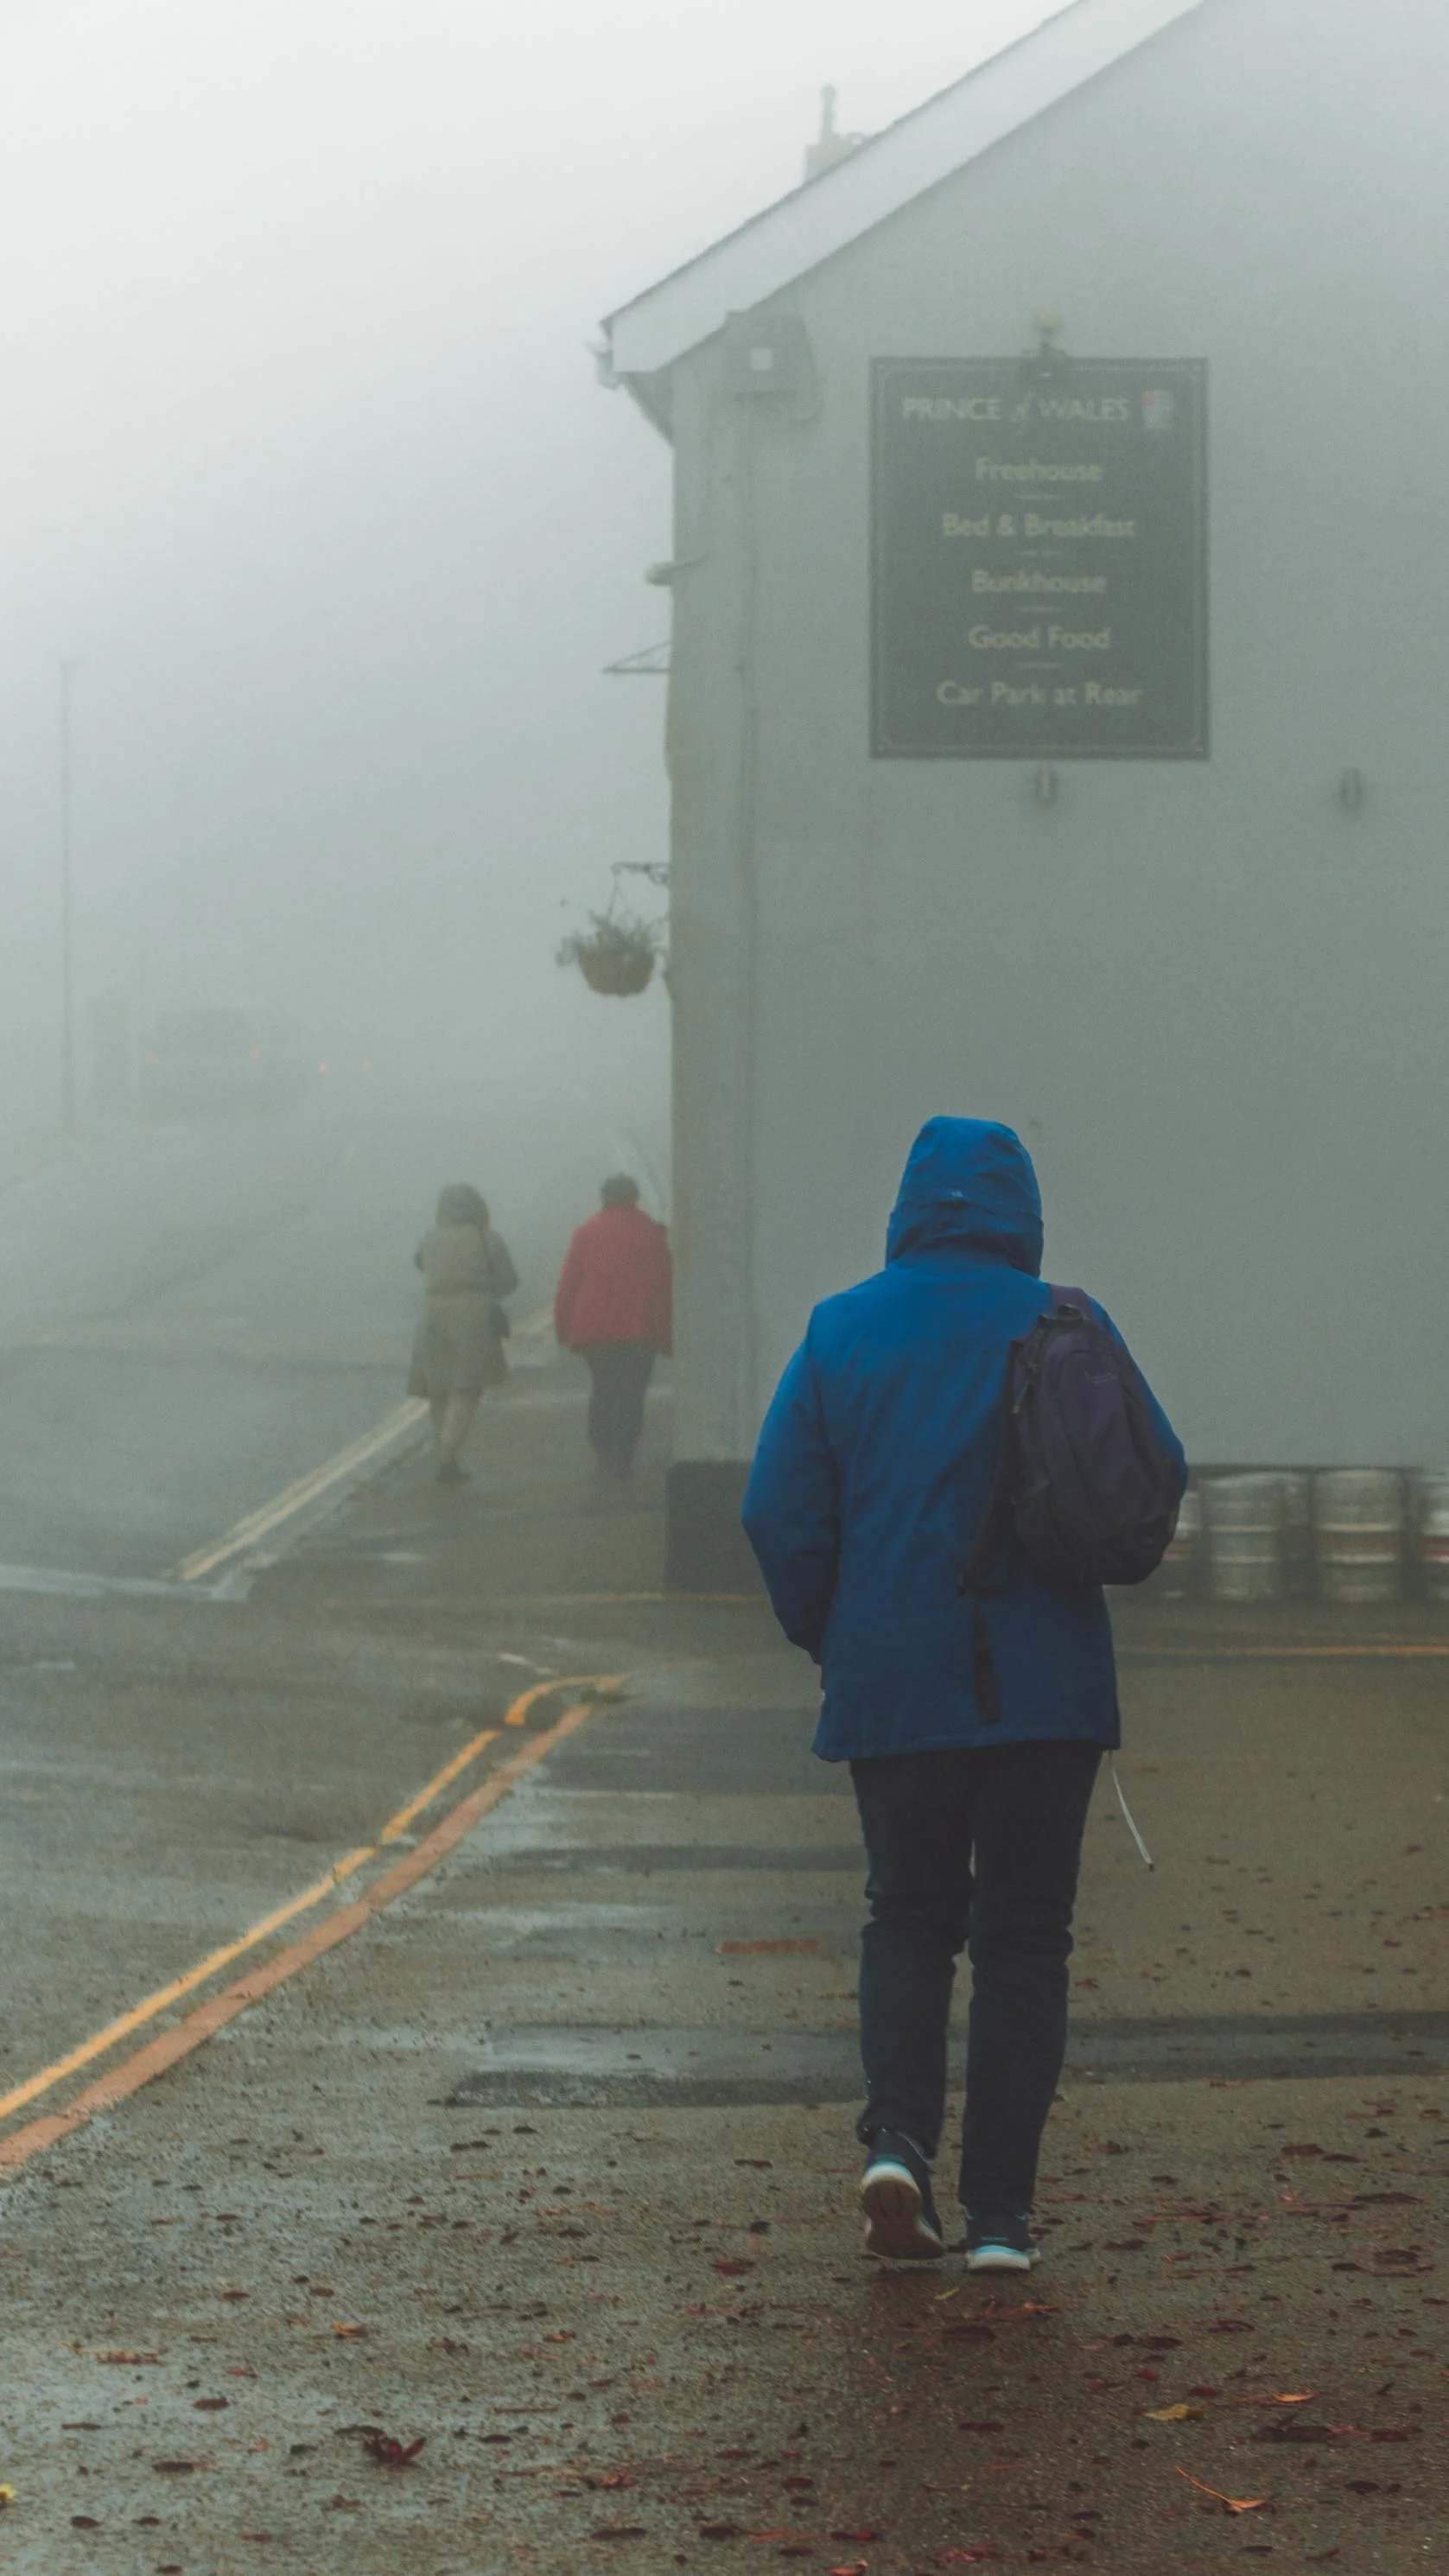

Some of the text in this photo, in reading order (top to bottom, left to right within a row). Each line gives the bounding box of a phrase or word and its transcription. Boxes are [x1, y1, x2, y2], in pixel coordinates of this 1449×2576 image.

[902, 396, 1001, 421] PRINCE
[1038, 397, 1129, 421] WALES
[975, 456, 1105, 481] Freehouse
[942, 512, 1138, 537] Bed & Breakfast
[971, 569, 1107, 594] Bunkhouse
[968, 624, 1112, 650] Good Food
[936, 680, 1144, 706] Car Park at Rear
